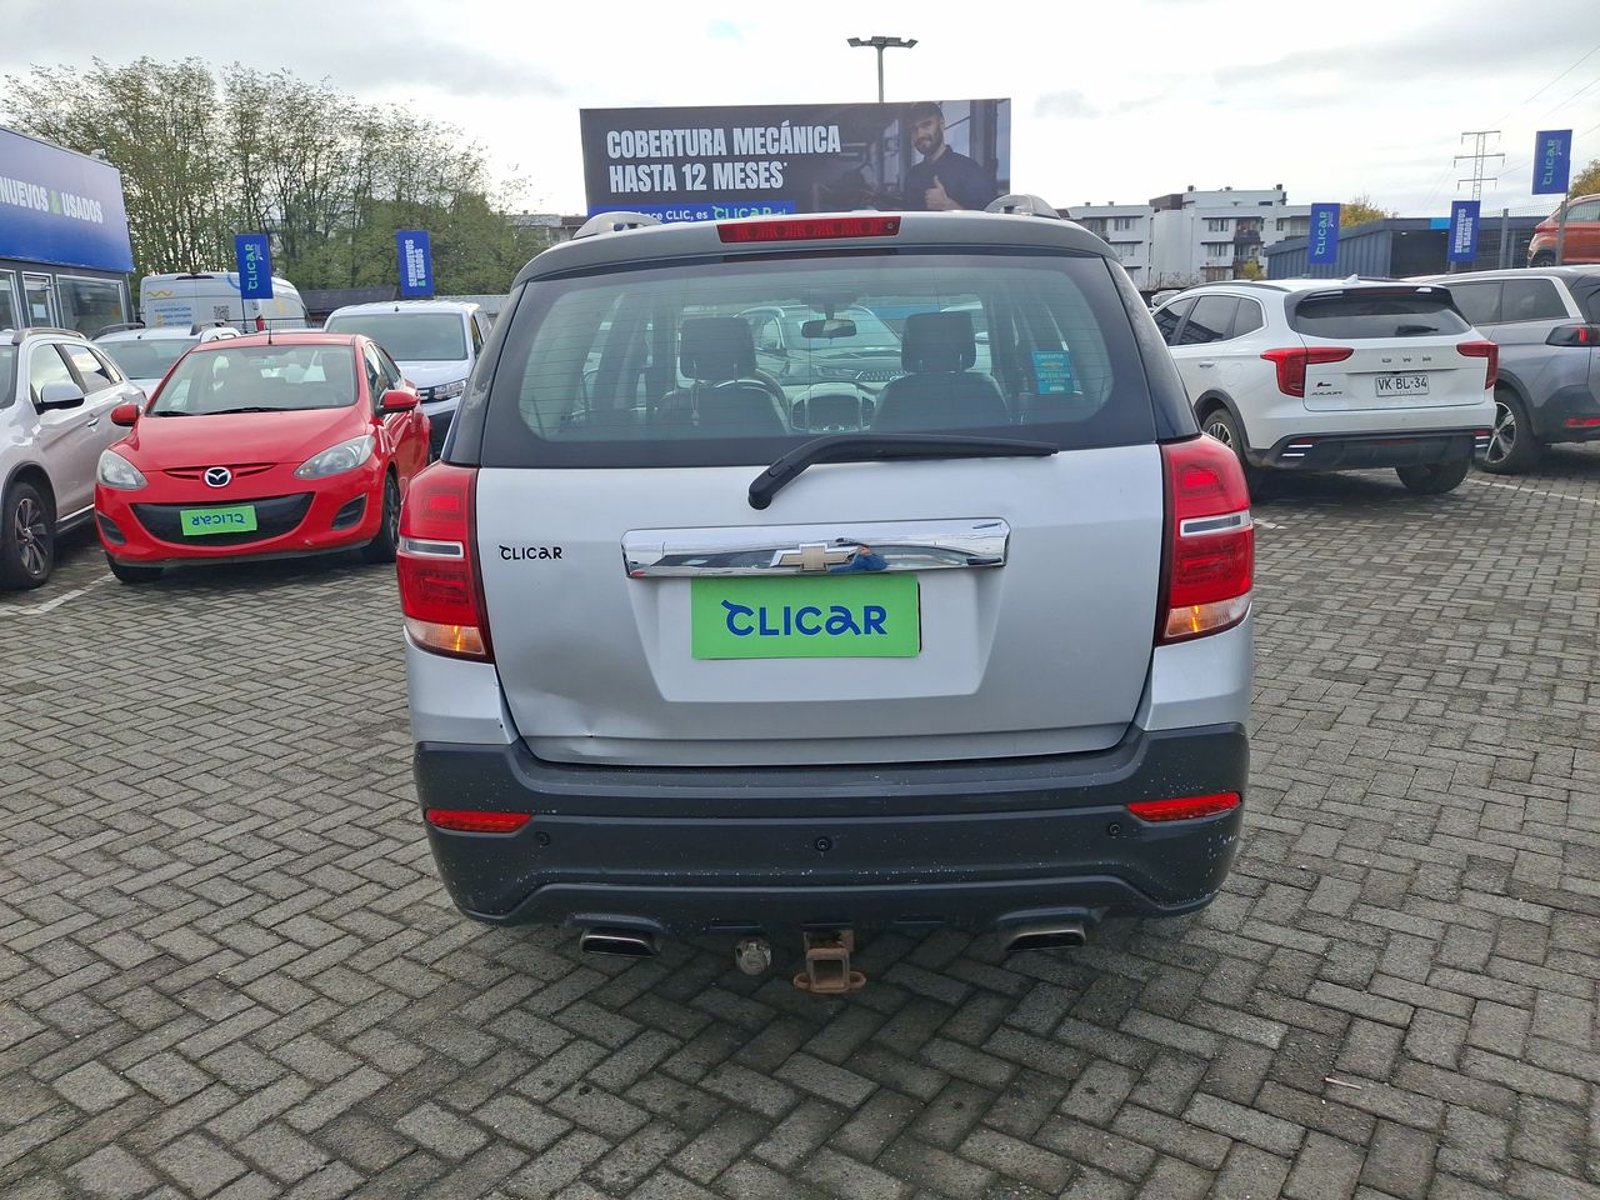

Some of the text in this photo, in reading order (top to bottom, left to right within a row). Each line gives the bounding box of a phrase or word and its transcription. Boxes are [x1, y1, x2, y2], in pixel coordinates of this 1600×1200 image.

[606, 119, 842, 159] COBERTURA MECÁNICA
[609, 163, 677, 193] HASTA
[682, 163, 708, 191] 12
[0, 175, 49, 213] NUEVOS
[61, 191, 104, 225] USADOS
[665, 209, 694, 221] CLIC,
[695, 210, 708, 220] es
[1454, 208, 1467, 253] SEMINUEVOS
[1463, 216, 1473, 246] USADOS
[404, 239, 418, 287] SEMINUEVOS
[414, 248, 426, 280] USADOS
